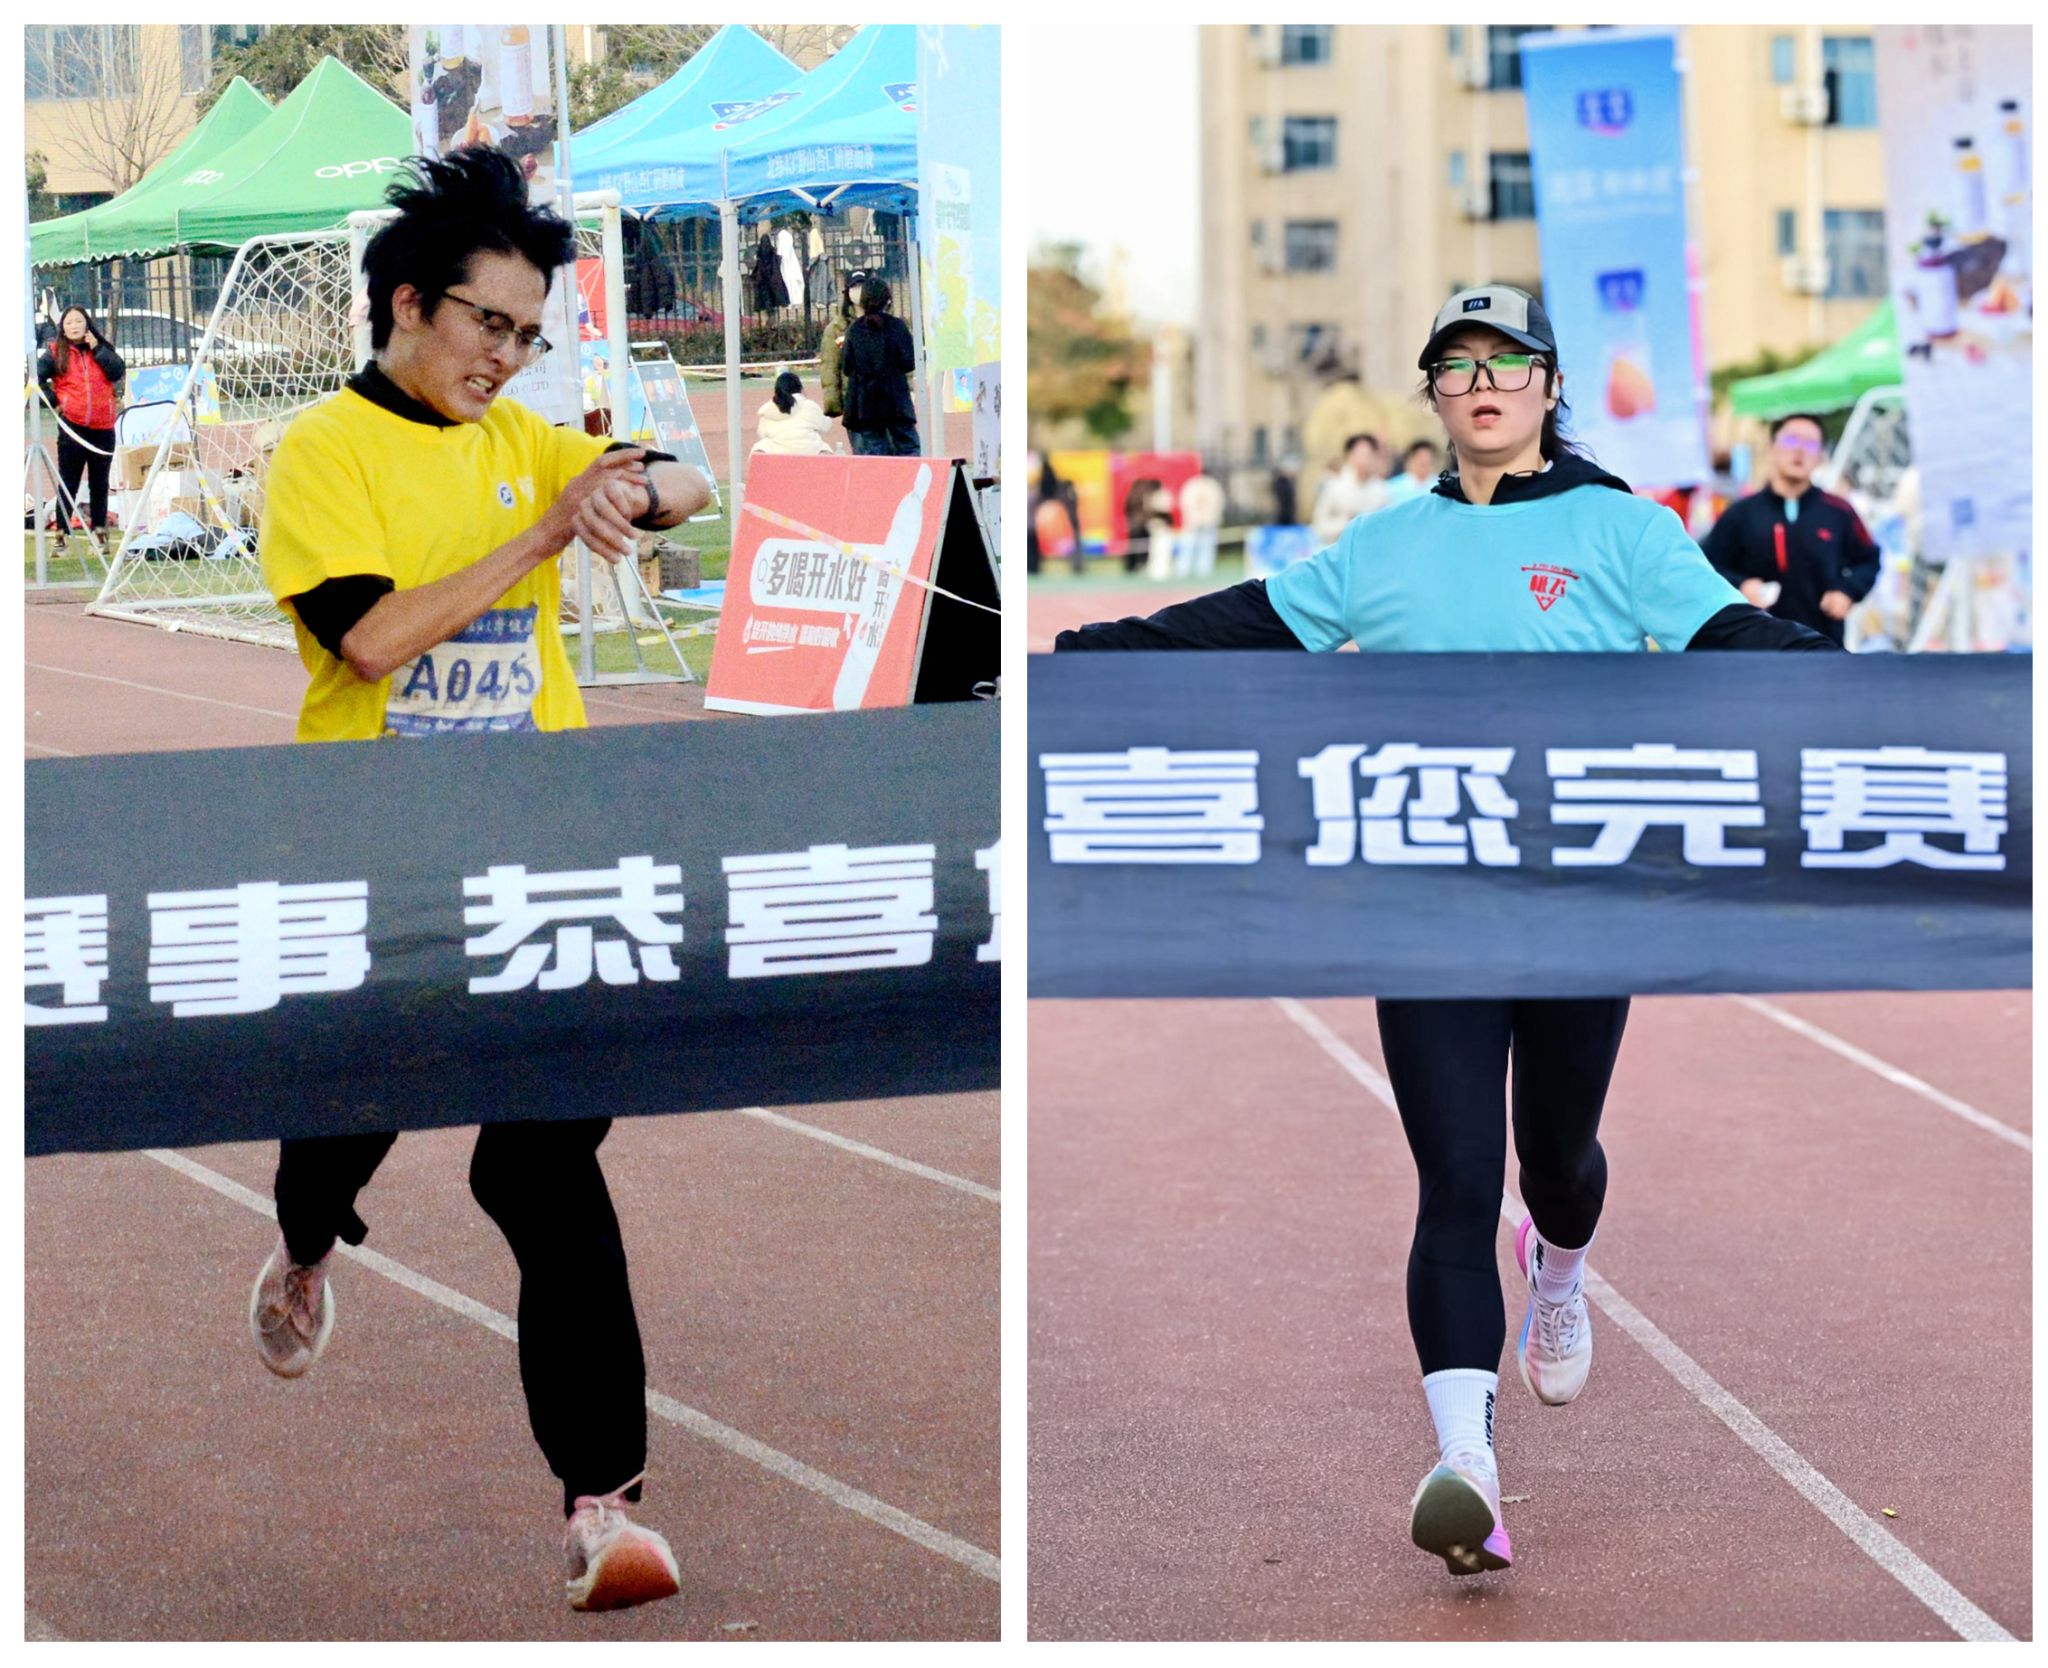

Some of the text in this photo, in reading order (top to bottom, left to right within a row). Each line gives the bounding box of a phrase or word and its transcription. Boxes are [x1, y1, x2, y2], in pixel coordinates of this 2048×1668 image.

[766, 549, 868, 603] 多喝开水好
[1038, 743, 2008, 870] 喜您完赛
